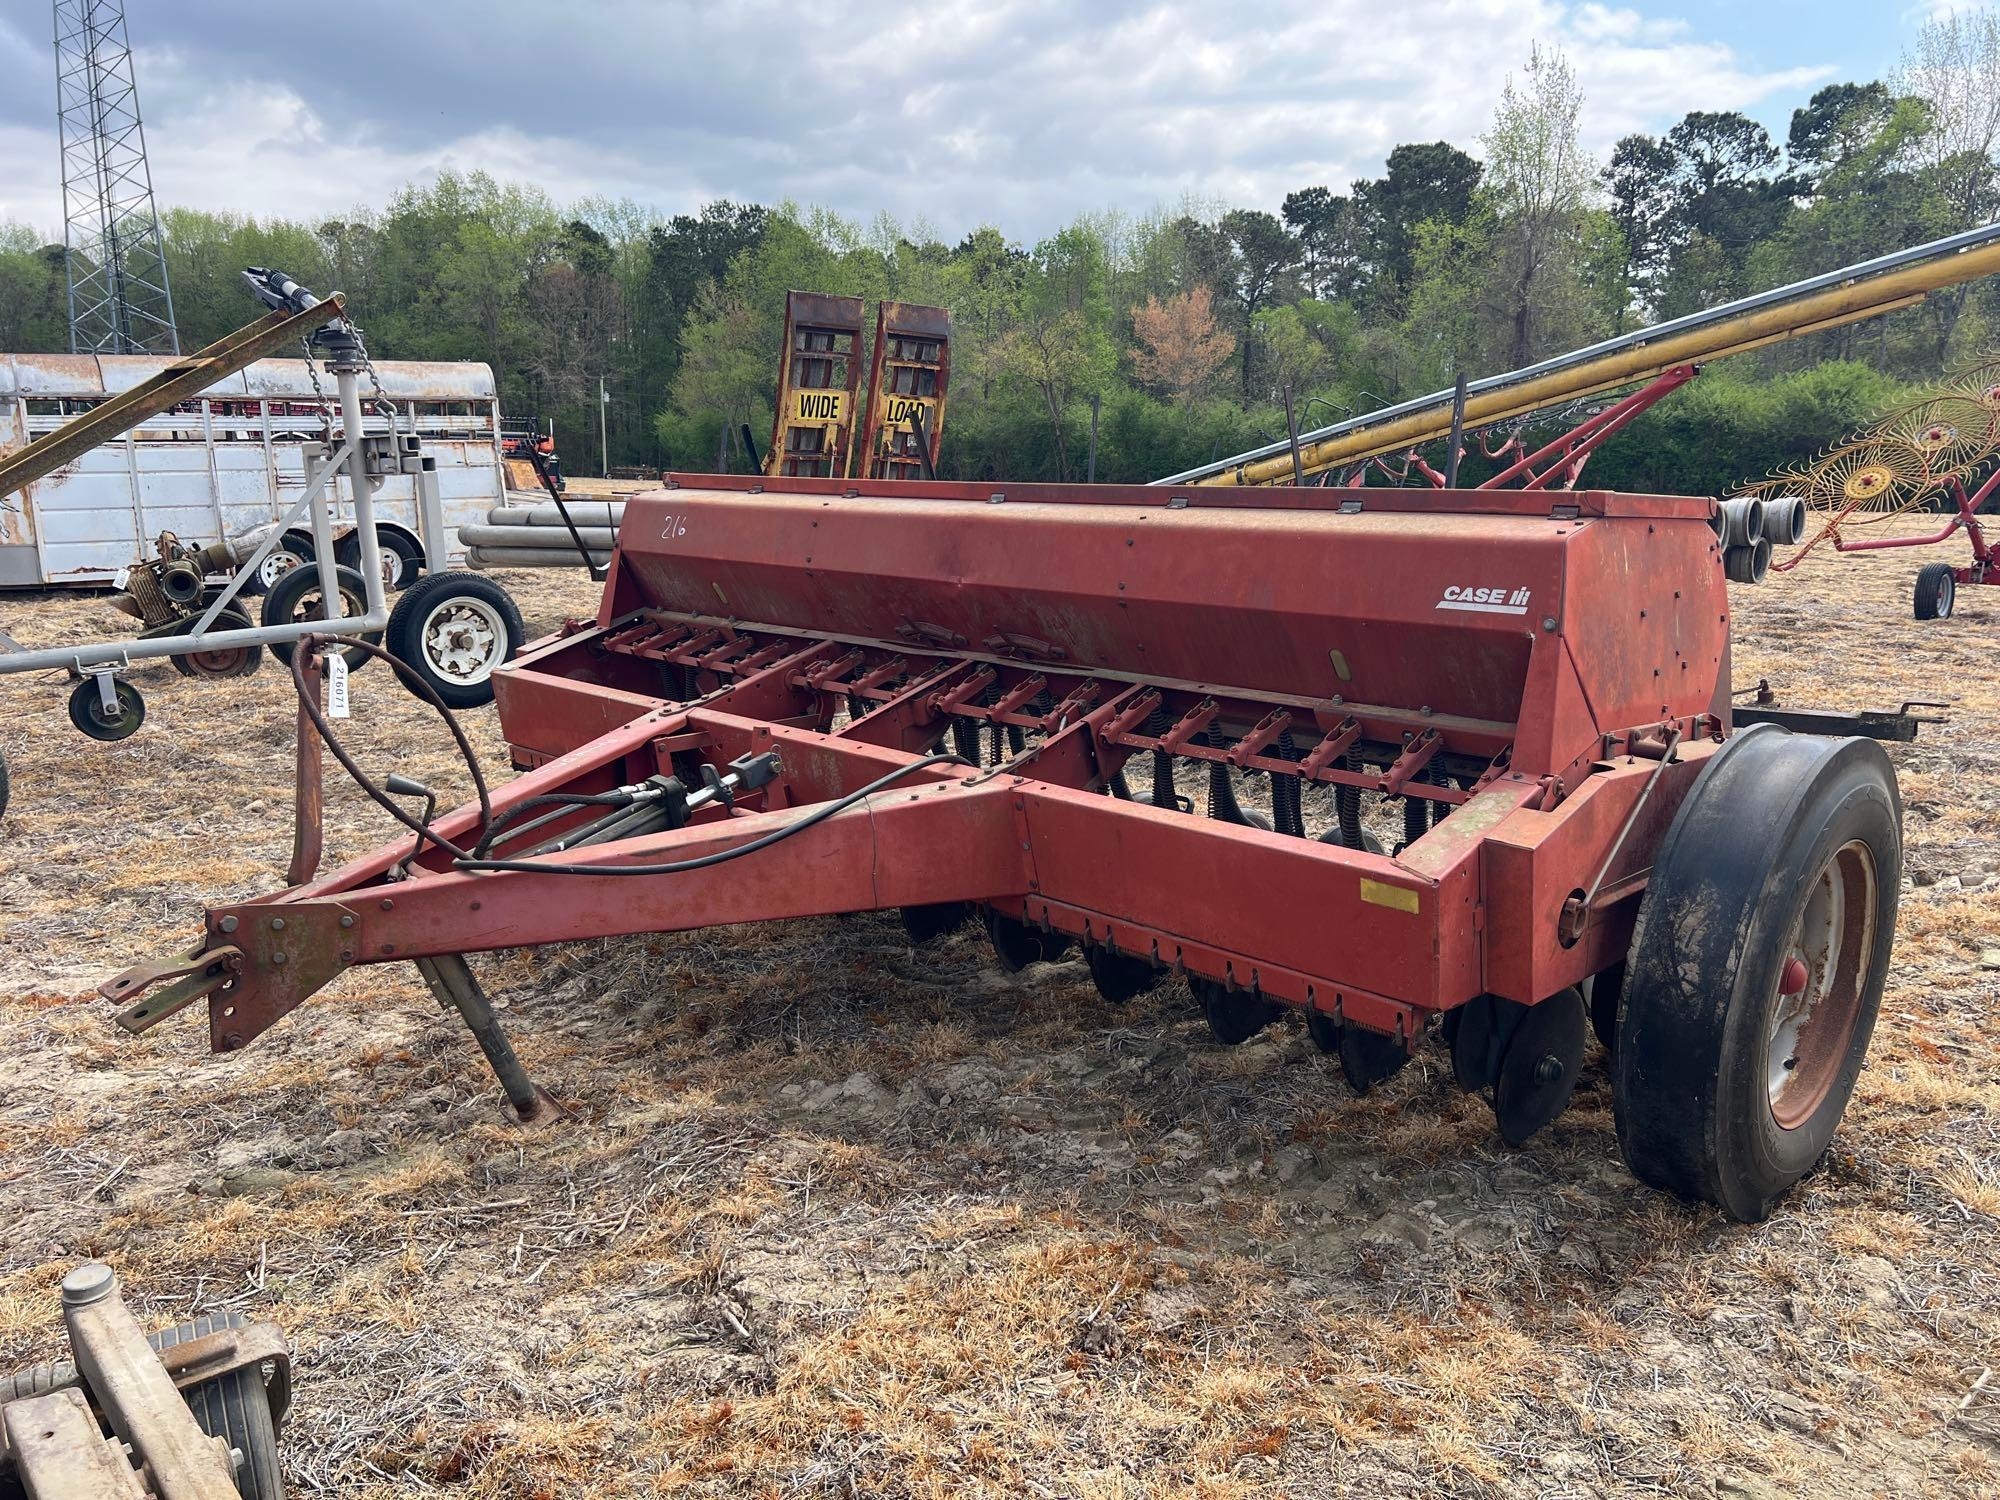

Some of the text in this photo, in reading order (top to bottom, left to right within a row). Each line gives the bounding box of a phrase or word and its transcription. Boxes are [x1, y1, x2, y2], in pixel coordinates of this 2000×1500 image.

[800, 394, 840, 419] WIDE
[887, 400, 925, 423] LOAD
[661, 515, 687, 539] 216
[1443, 585, 1507, 604] CASE
[336, 667, 345, 708] 216071
